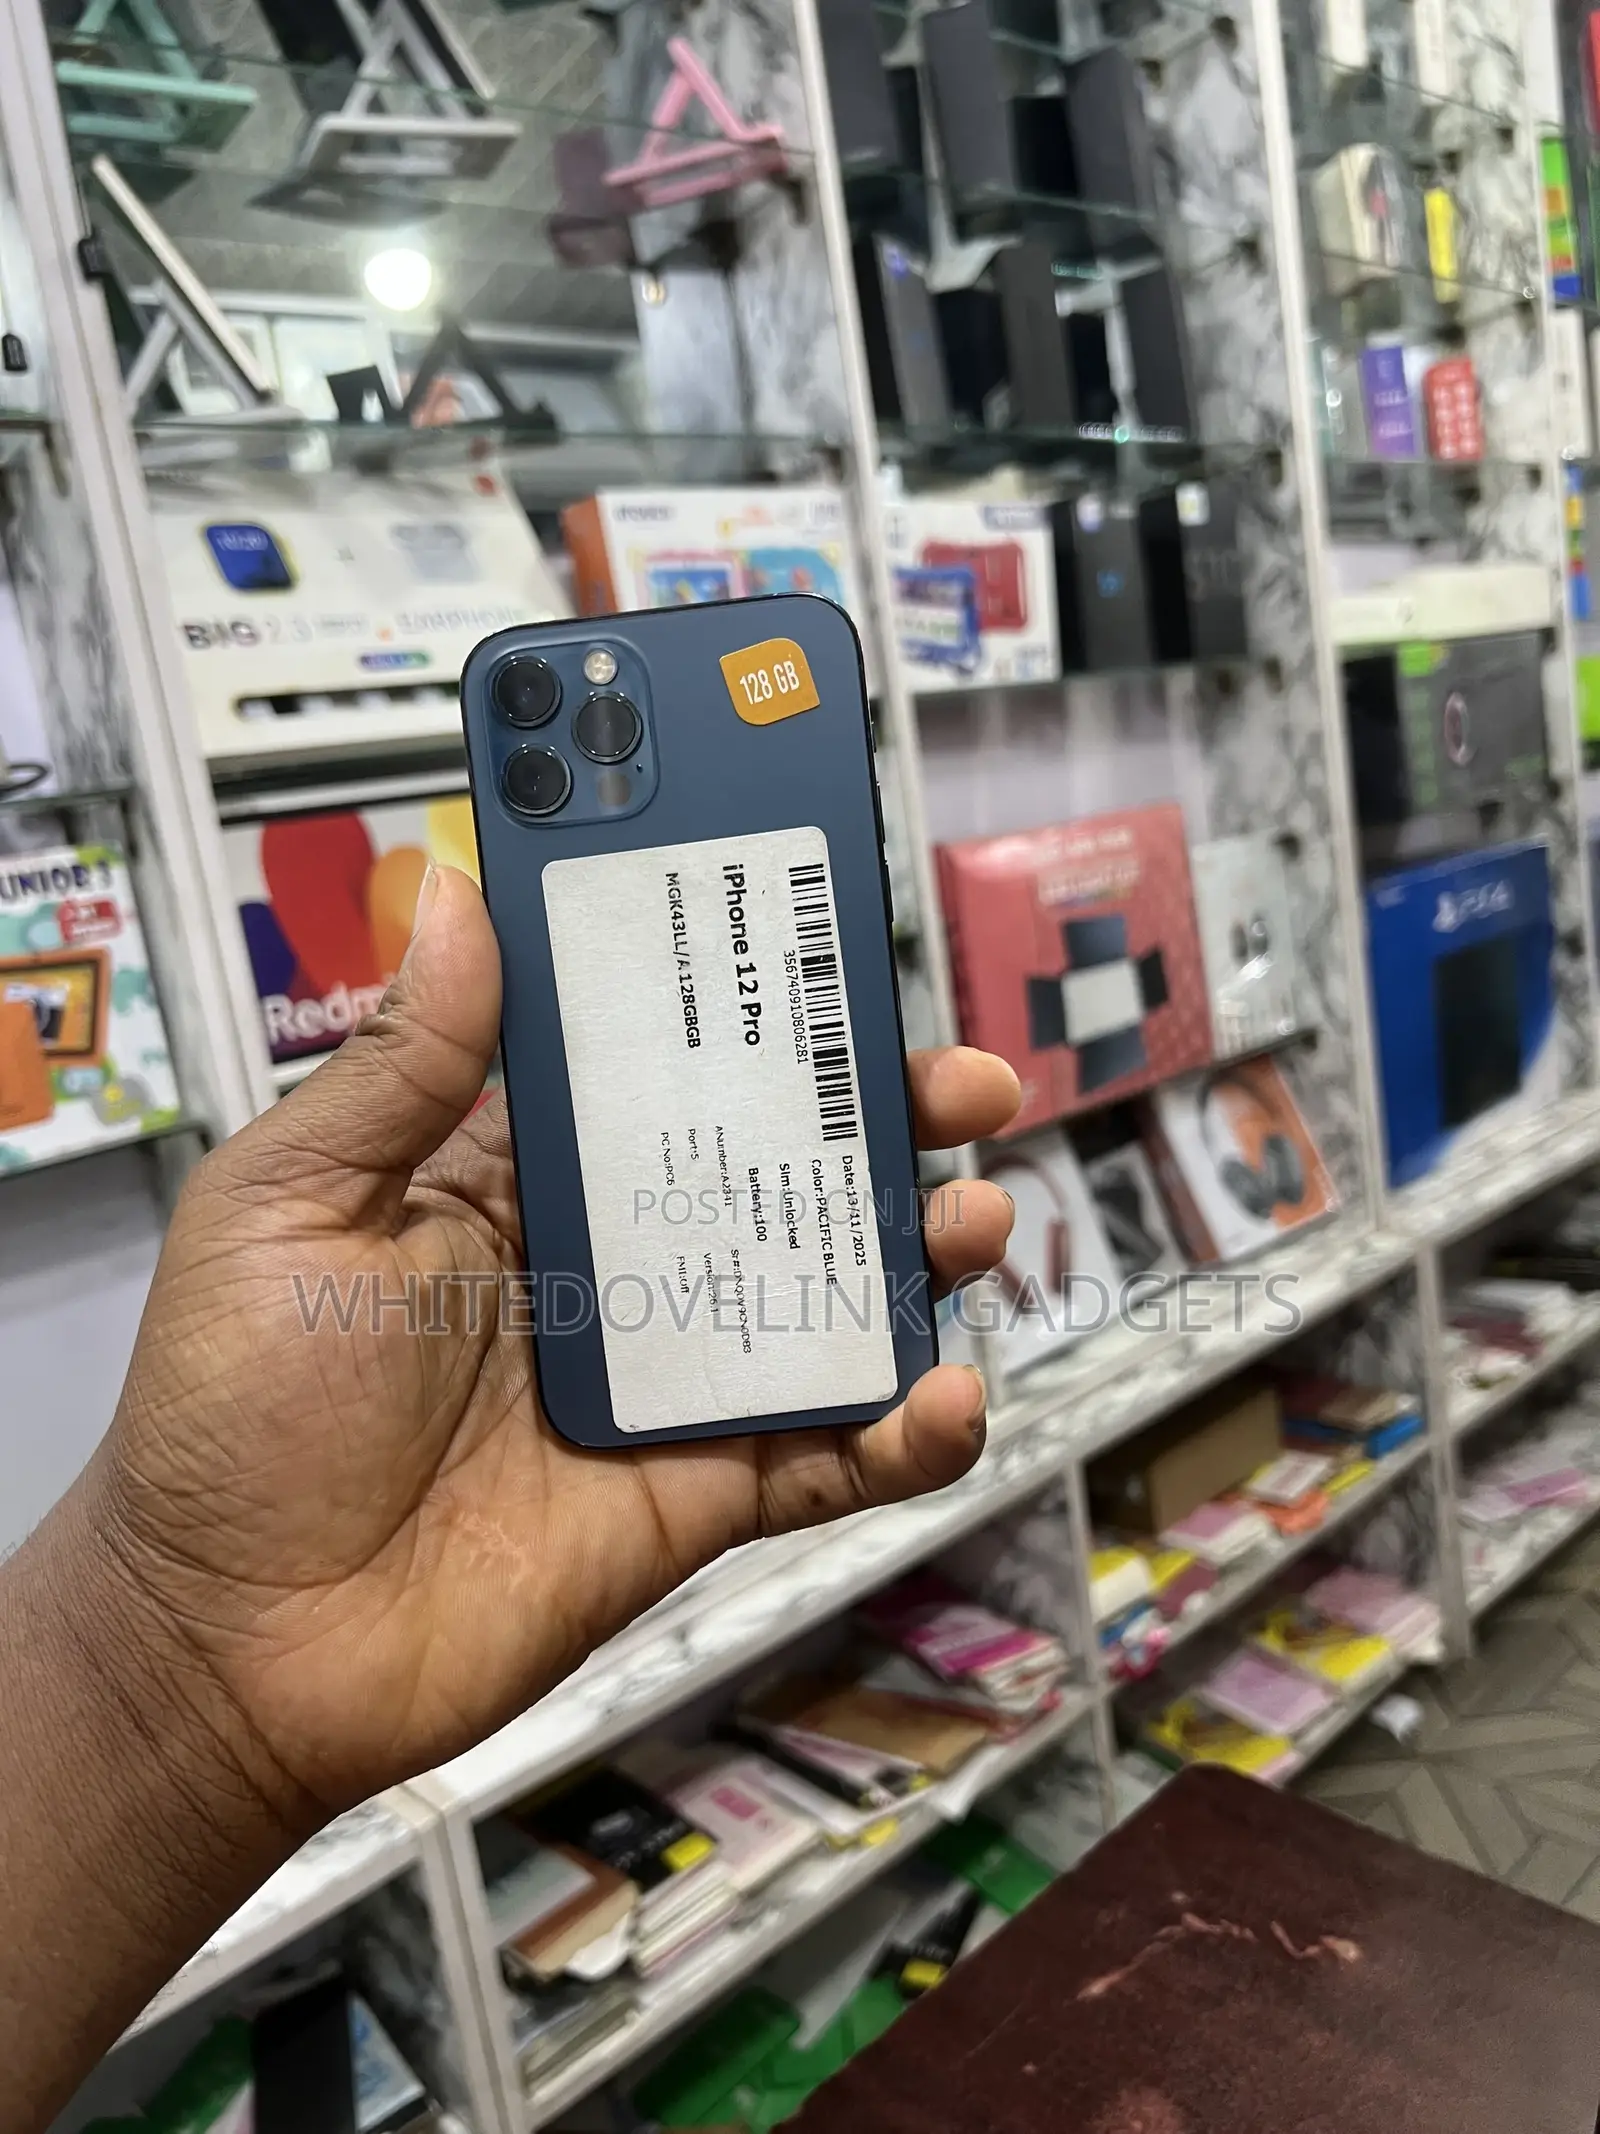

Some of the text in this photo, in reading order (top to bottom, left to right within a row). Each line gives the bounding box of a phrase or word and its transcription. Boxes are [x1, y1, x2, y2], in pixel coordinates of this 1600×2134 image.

[740, 660, 800, 705] 128 GB
[664, 871, 701, 1049] MGK43LL/A 128GBGB
[721, 862, 762, 1046] iPhone 12 Pro
[782, 948, 809, 1065] 356740910806281
[660, 1131, 670, 1146] PC
[747, 1166, 768, 1242] Battery:100
[778, 1162, 801, 1250] Sim:Unlocked
[810, 1158, 838, 1285] Color:PACIFIC BLUE
[841, 1154, 867, 1266] Date:13/11/2025
